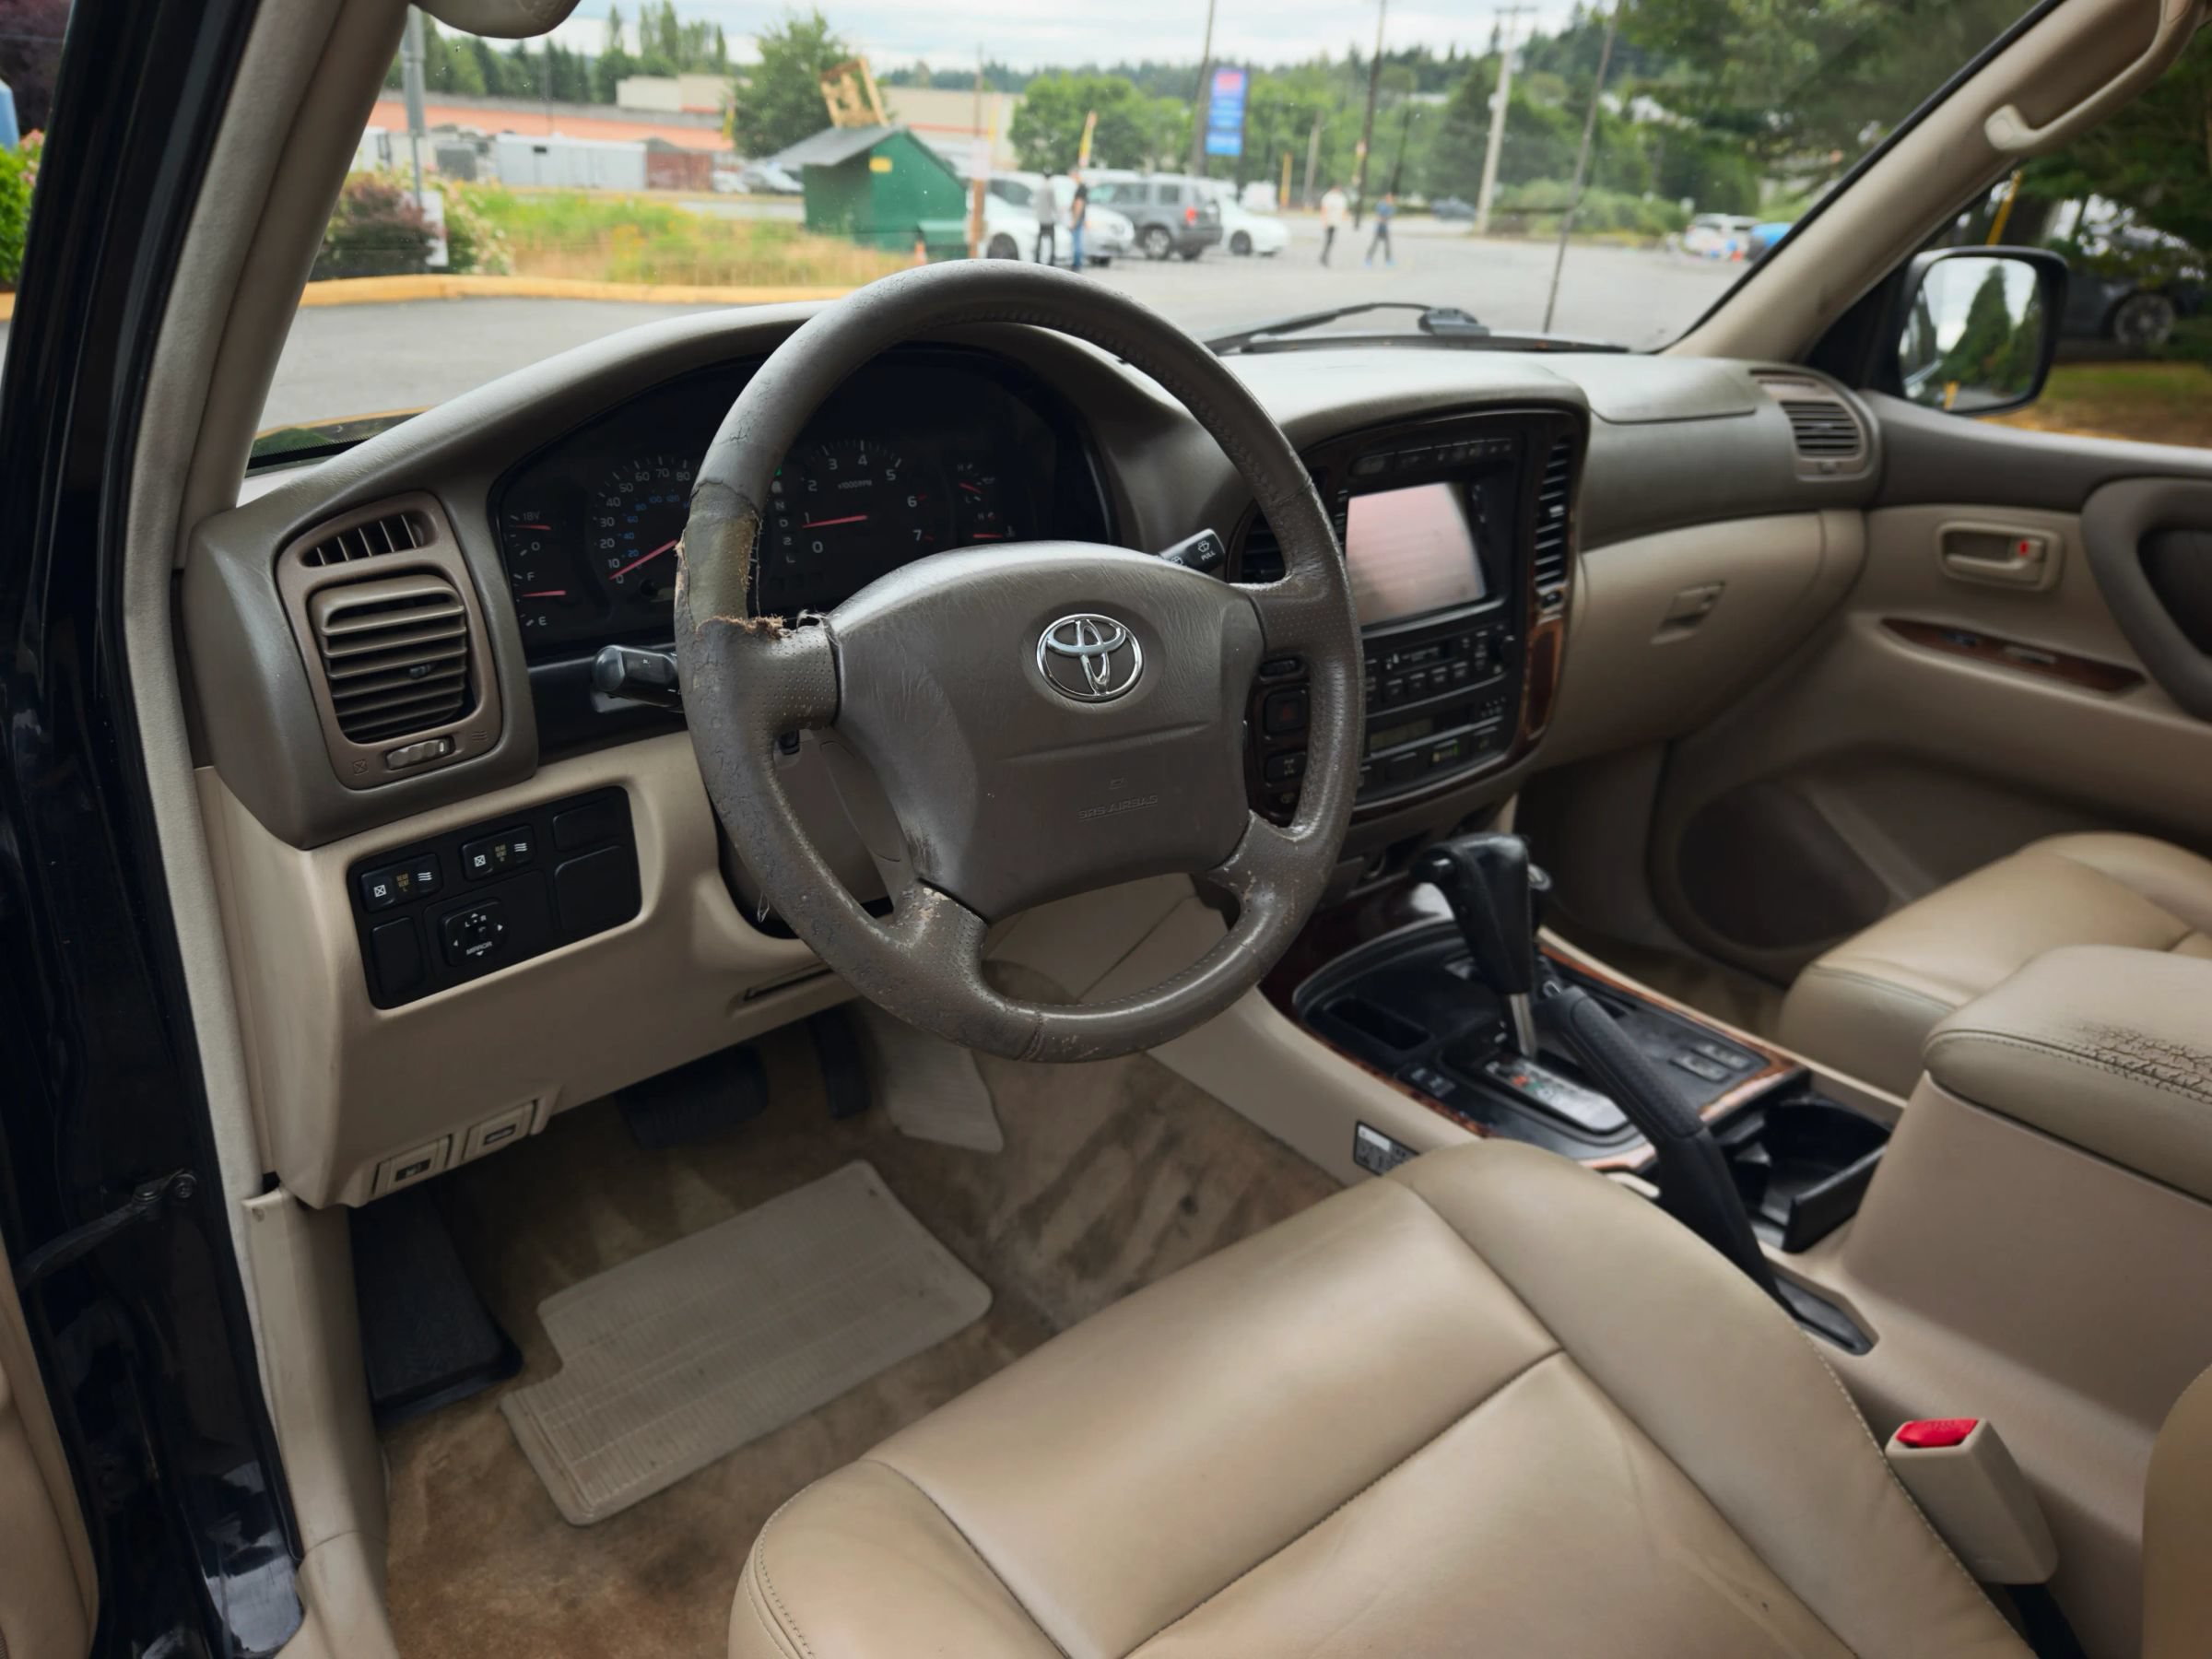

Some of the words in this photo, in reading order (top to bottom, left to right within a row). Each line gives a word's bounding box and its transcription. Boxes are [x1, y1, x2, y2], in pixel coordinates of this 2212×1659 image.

[828, 458, 839, 470] 3
[858, 453, 868, 465] 4
[634, 472, 650, 482] 60
[655, 468, 670, 478] 70
[676, 471, 690, 481] 80
[885, 469, 897, 481] 5
[619, 482, 634, 493] 50
[807, 479, 818, 492] 2
[606, 497, 621, 508] 40
[774, 500, 785, 511] N
[907, 496, 917, 508] 6
[600, 517, 616, 528] 30
[779, 518, 788, 528] D
[804, 512, 810, 524] 1
[912, 529, 924, 542] 7
[599, 538, 616, 549] 20
[812, 540, 824, 554] 0
[627, 548, 640, 558] 20
[786, 553, 795, 563] L
[1201, 549, 1217, 561] PULL
[607, 558, 620, 569] 10
[526, 571, 535, 581] F
[616, 575, 625, 584] 0
[538, 616, 547, 626] E
